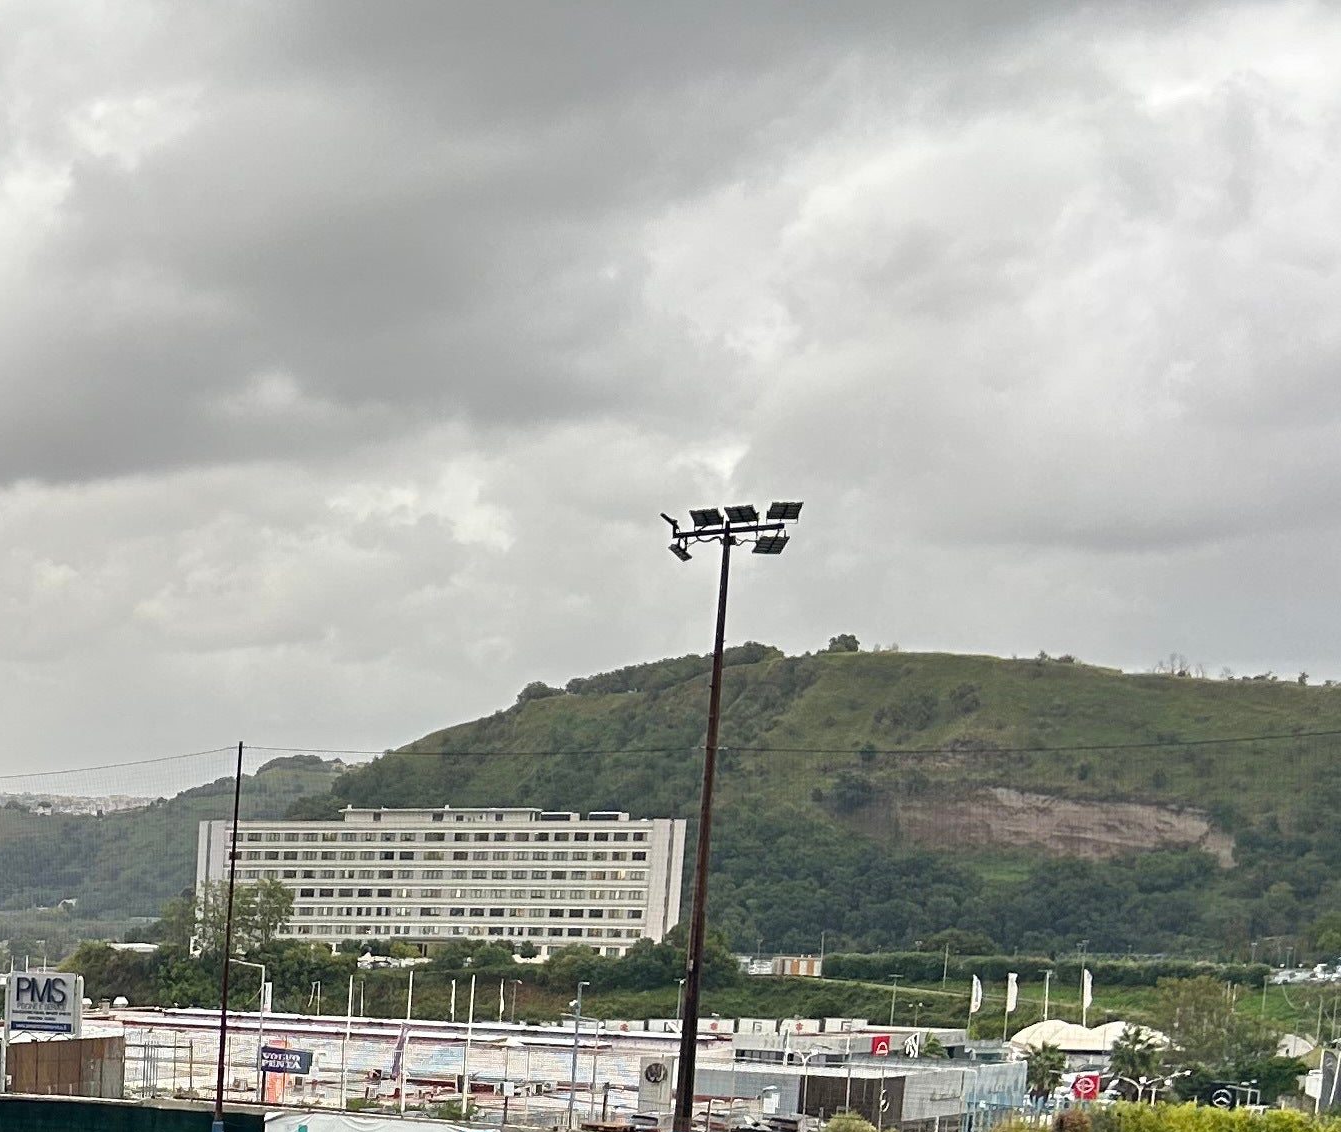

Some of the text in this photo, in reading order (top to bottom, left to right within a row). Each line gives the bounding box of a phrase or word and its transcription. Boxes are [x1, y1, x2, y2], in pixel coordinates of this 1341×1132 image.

[16, 976, 67, 1004] PMS
[262, 1052, 301, 1061] VOLVO
[261, 1059, 302, 1070] PENTA
